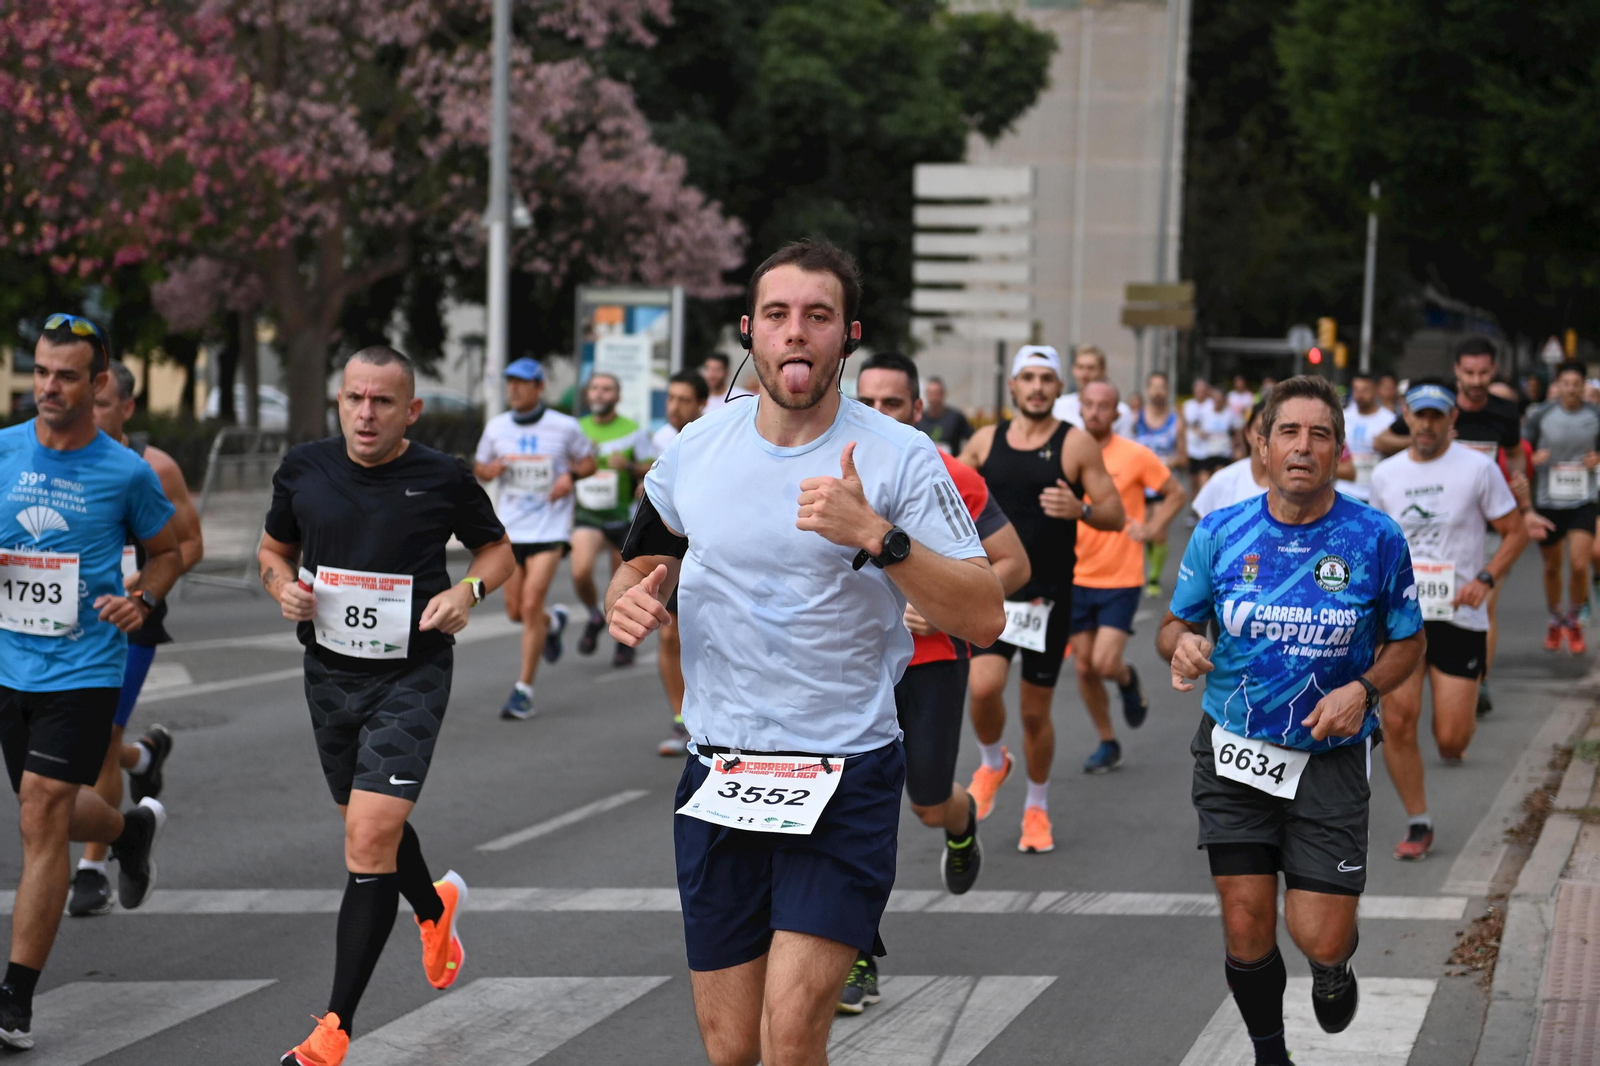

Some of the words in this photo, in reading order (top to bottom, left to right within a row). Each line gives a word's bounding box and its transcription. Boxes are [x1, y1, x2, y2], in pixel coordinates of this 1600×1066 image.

[7, 493, 37, 504] CIUDAD
[38, 497, 50, 506] DE
[12, 485, 49, 496] CARRERA
[51, 491, 86, 504] URBANA
[320, 571, 339, 587] 42
[3, 578, 63, 605] 1793
[344, 605, 378, 629] 85
[1222, 599, 1257, 638] V
[1254, 604, 1312, 624] CARRERA
[1319, 607, 1358, 626] CROSS
[1250, 621, 1356, 645] POPULAR
[1283, 645, 1290, 655] 7
[1289, 645, 1300, 656] de
[1300, 646, 1323, 659] Mayo
[1323, 647, 1334, 658] de
[746, 761, 796, 772] CARRERA
[1218, 743, 1287, 785] 6634
[716, 781, 812, 807] 3552
